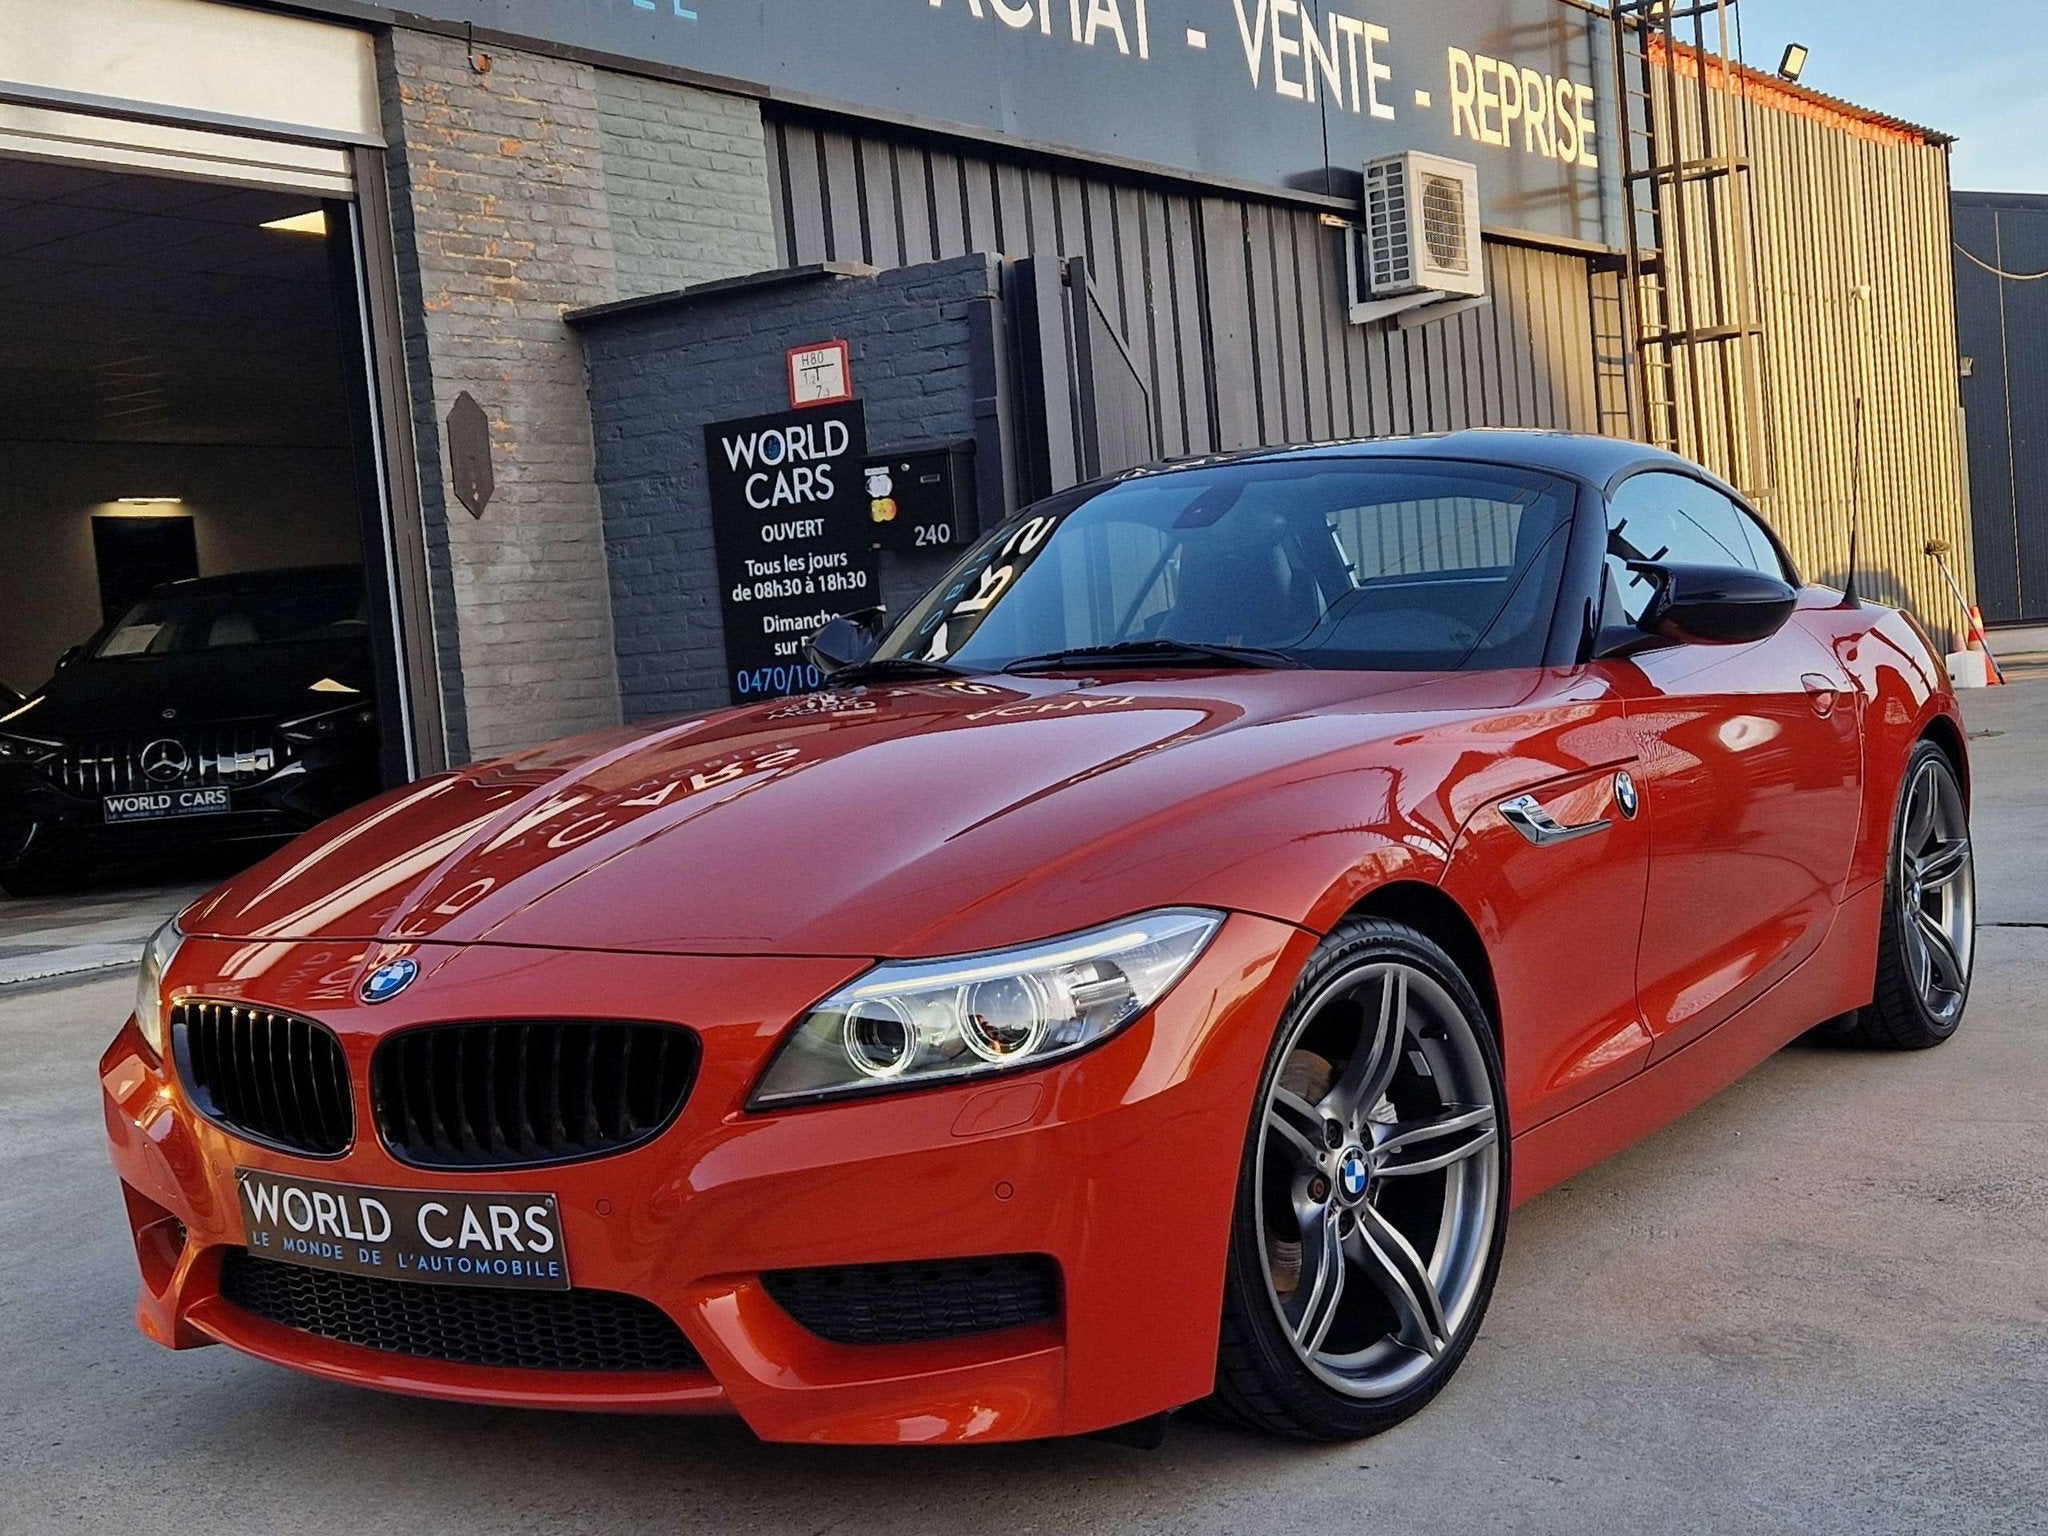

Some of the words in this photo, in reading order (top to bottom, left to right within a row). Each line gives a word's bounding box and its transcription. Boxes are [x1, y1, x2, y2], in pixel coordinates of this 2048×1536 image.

[1233, 0, 1396, 120] VENTE
[1447, 46, 1598, 168] REPRISE
[721, 420, 849, 472] WORLD
[745, 464, 835, 509] CARS
[761, 518, 825, 543] OUVERT
[914, 523, 951, 546] 240
[745, 559, 781, 577] Tous
[784, 554, 805, 572] les
[807, 551, 848, 575] jours
[732, 584, 751, 602] de
[754, 578, 802, 599] 08h30
[805, 577, 815, 593] à
[818, 571, 867, 591] 18h30
[774, 640, 798, 656] sur
[107, 795, 171, 812] WORLD
[179, 790, 227, 807] CARS
[244, 1180, 392, 1244] WORLD
[417, 1202, 555, 1254] CARS
[252, 1231, 270, 1247] LE
[283, 1237, 344, 1260] MONDE
[358, 1248, 382, 1266] DE
[399, 1253, 560, 1278] L'AUTOMOBILE
